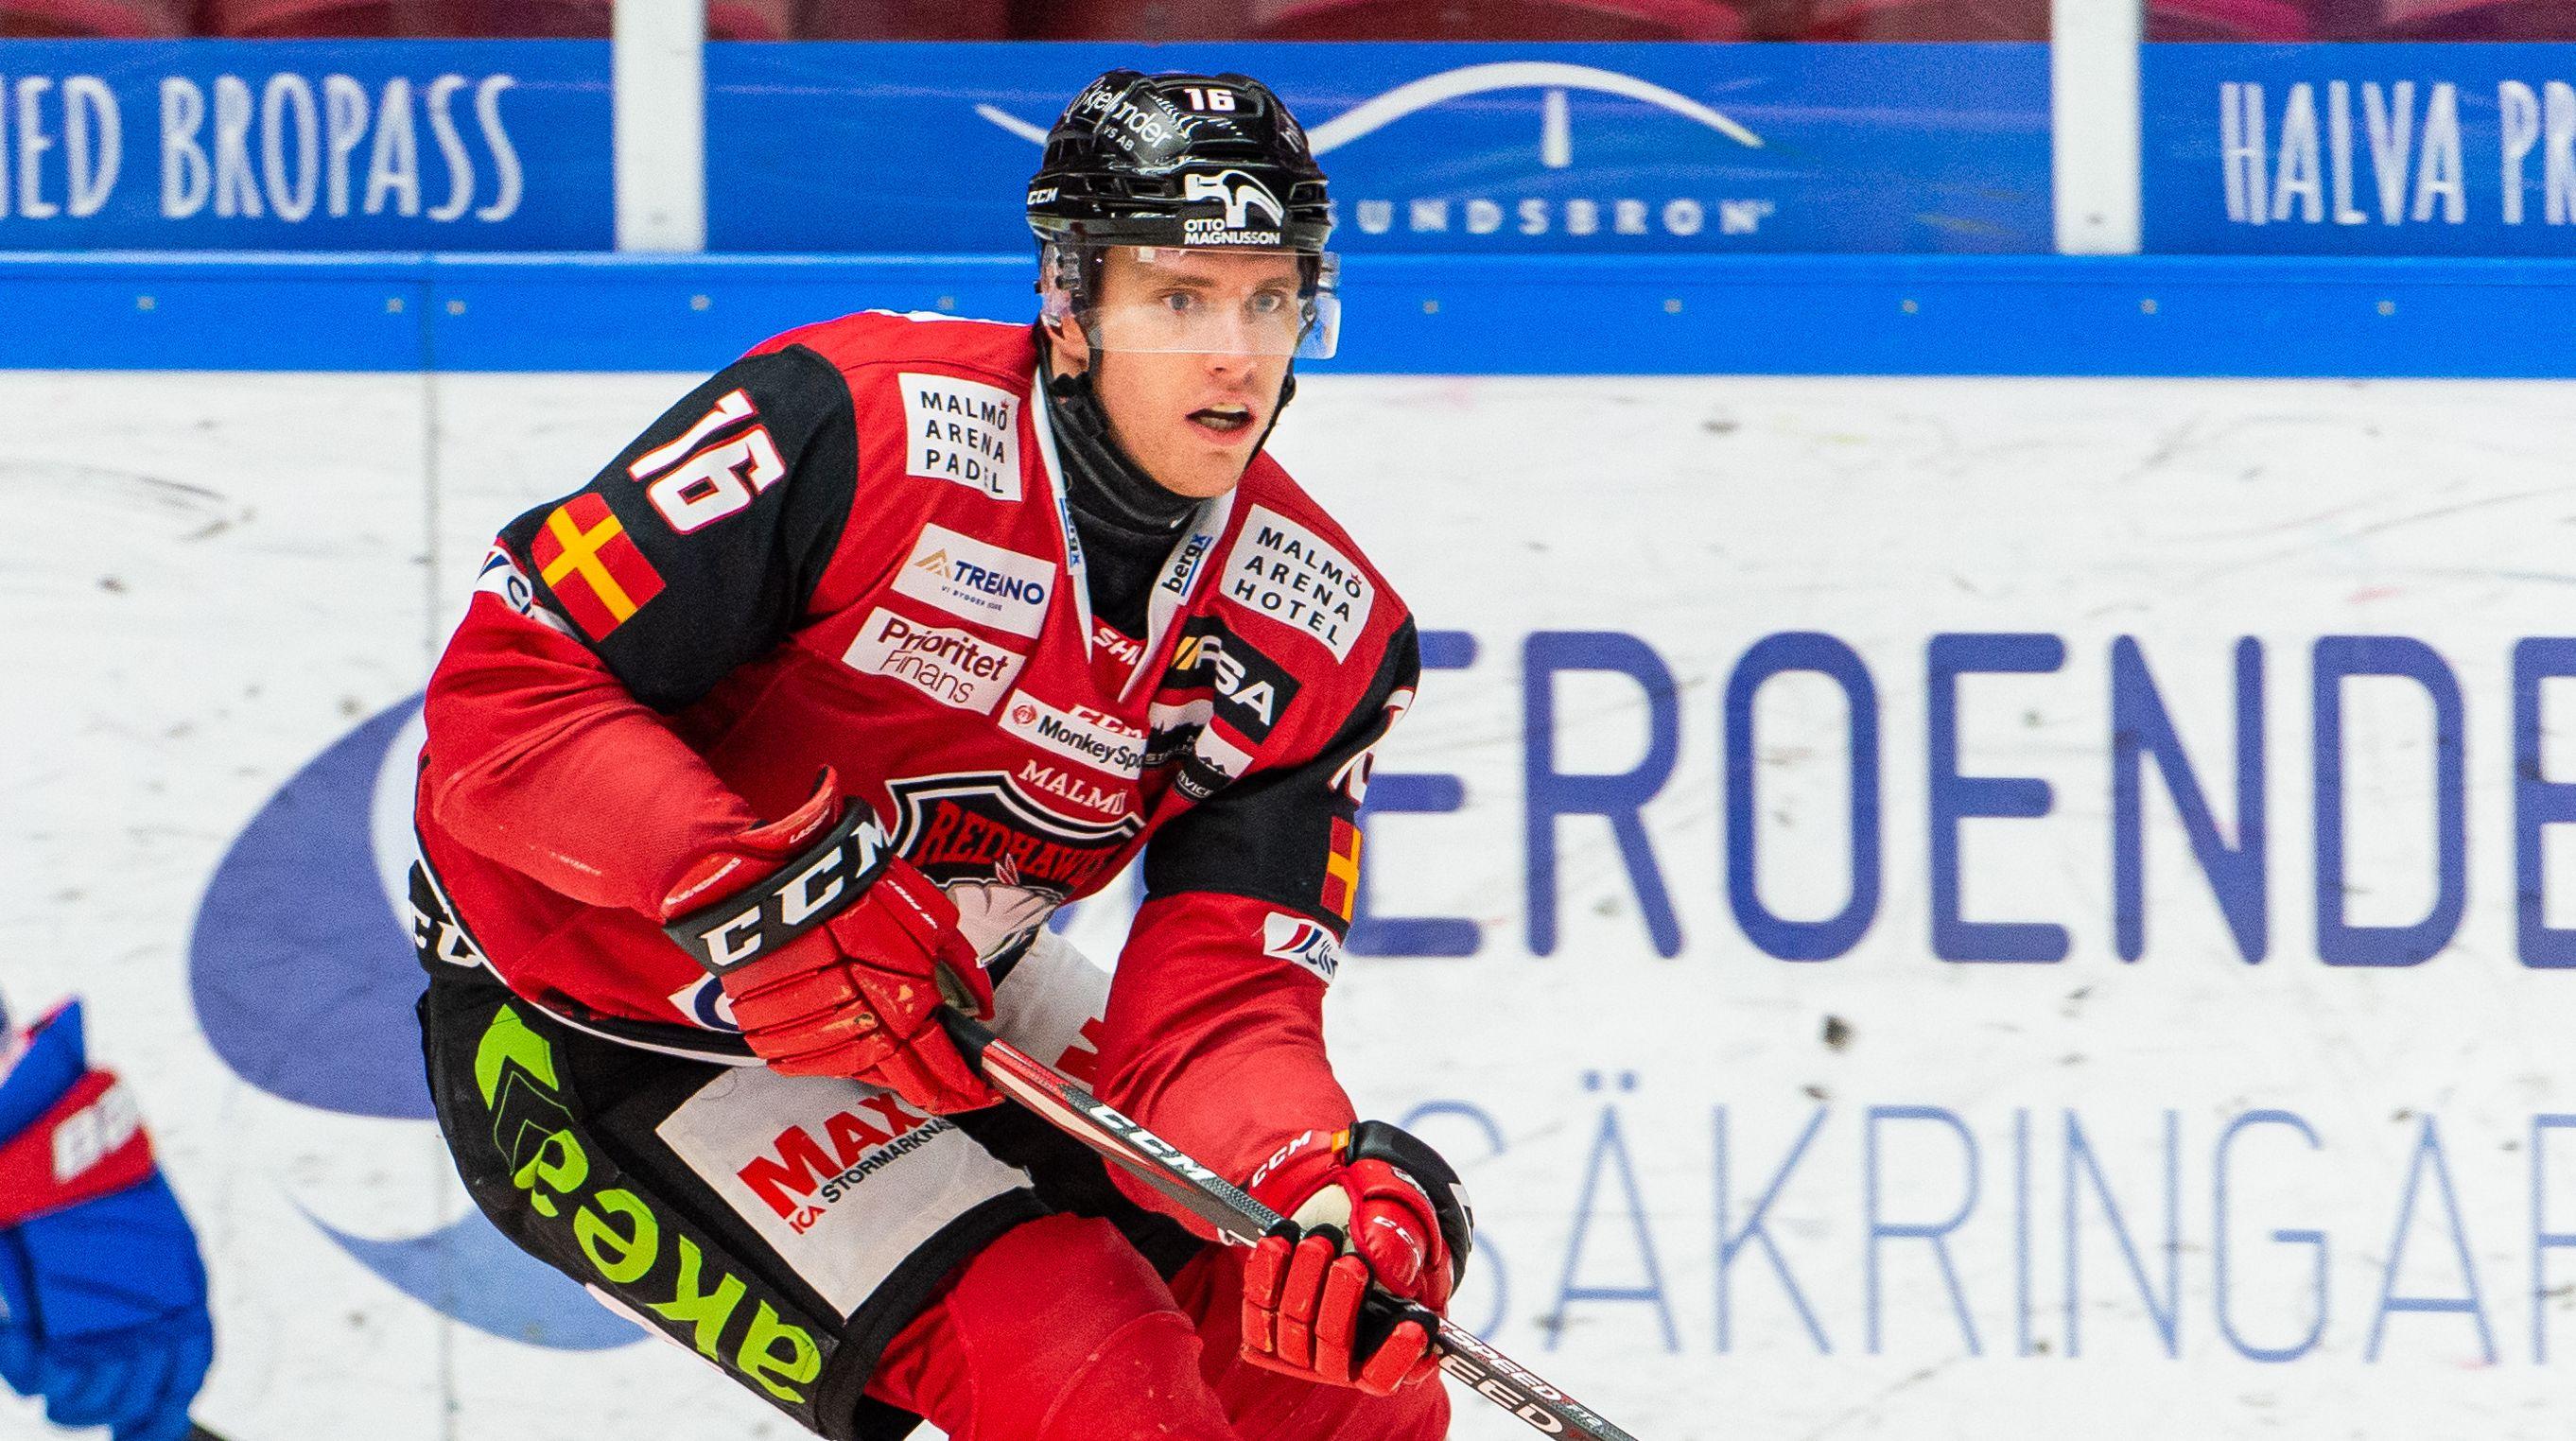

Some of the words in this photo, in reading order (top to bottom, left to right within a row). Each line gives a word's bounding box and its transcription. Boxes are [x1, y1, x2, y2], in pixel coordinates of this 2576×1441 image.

[1184, 88, 1235, 111] 16
[159, 73, 523, 221] BROPASS
[1116, 135, 1135, 151] AB
[2219, 79, 2465, 226] HALVA
[1027, 187, 1057, 205] CCM
[1184, 218, 1226, 232] OTTO
[1184, 232, 1280, 245] MAGNUSSON
[920, 391, 1009, 431] MALMÖ
[926, 419, 1004, 464] ARENA
[627, 387, 786, 535] 16
[1162, 533, 1212, 597] bergx
[1244, 555, 1350, 623] ARENA
[1257, 526, 1363, 599] MALMÖ
[1234, 578, 1338, 647] HOTEL
[878, 616, 1009, 682] Prioritet
[879, 649, 975, 704] Finans
[700, 821, 892, 966] CCM
[1088, 1104, 1218, 1181] CCM
[1251, 1129, 1314, 1189] CCM
[788, 1205, 827, 1236] ICA
